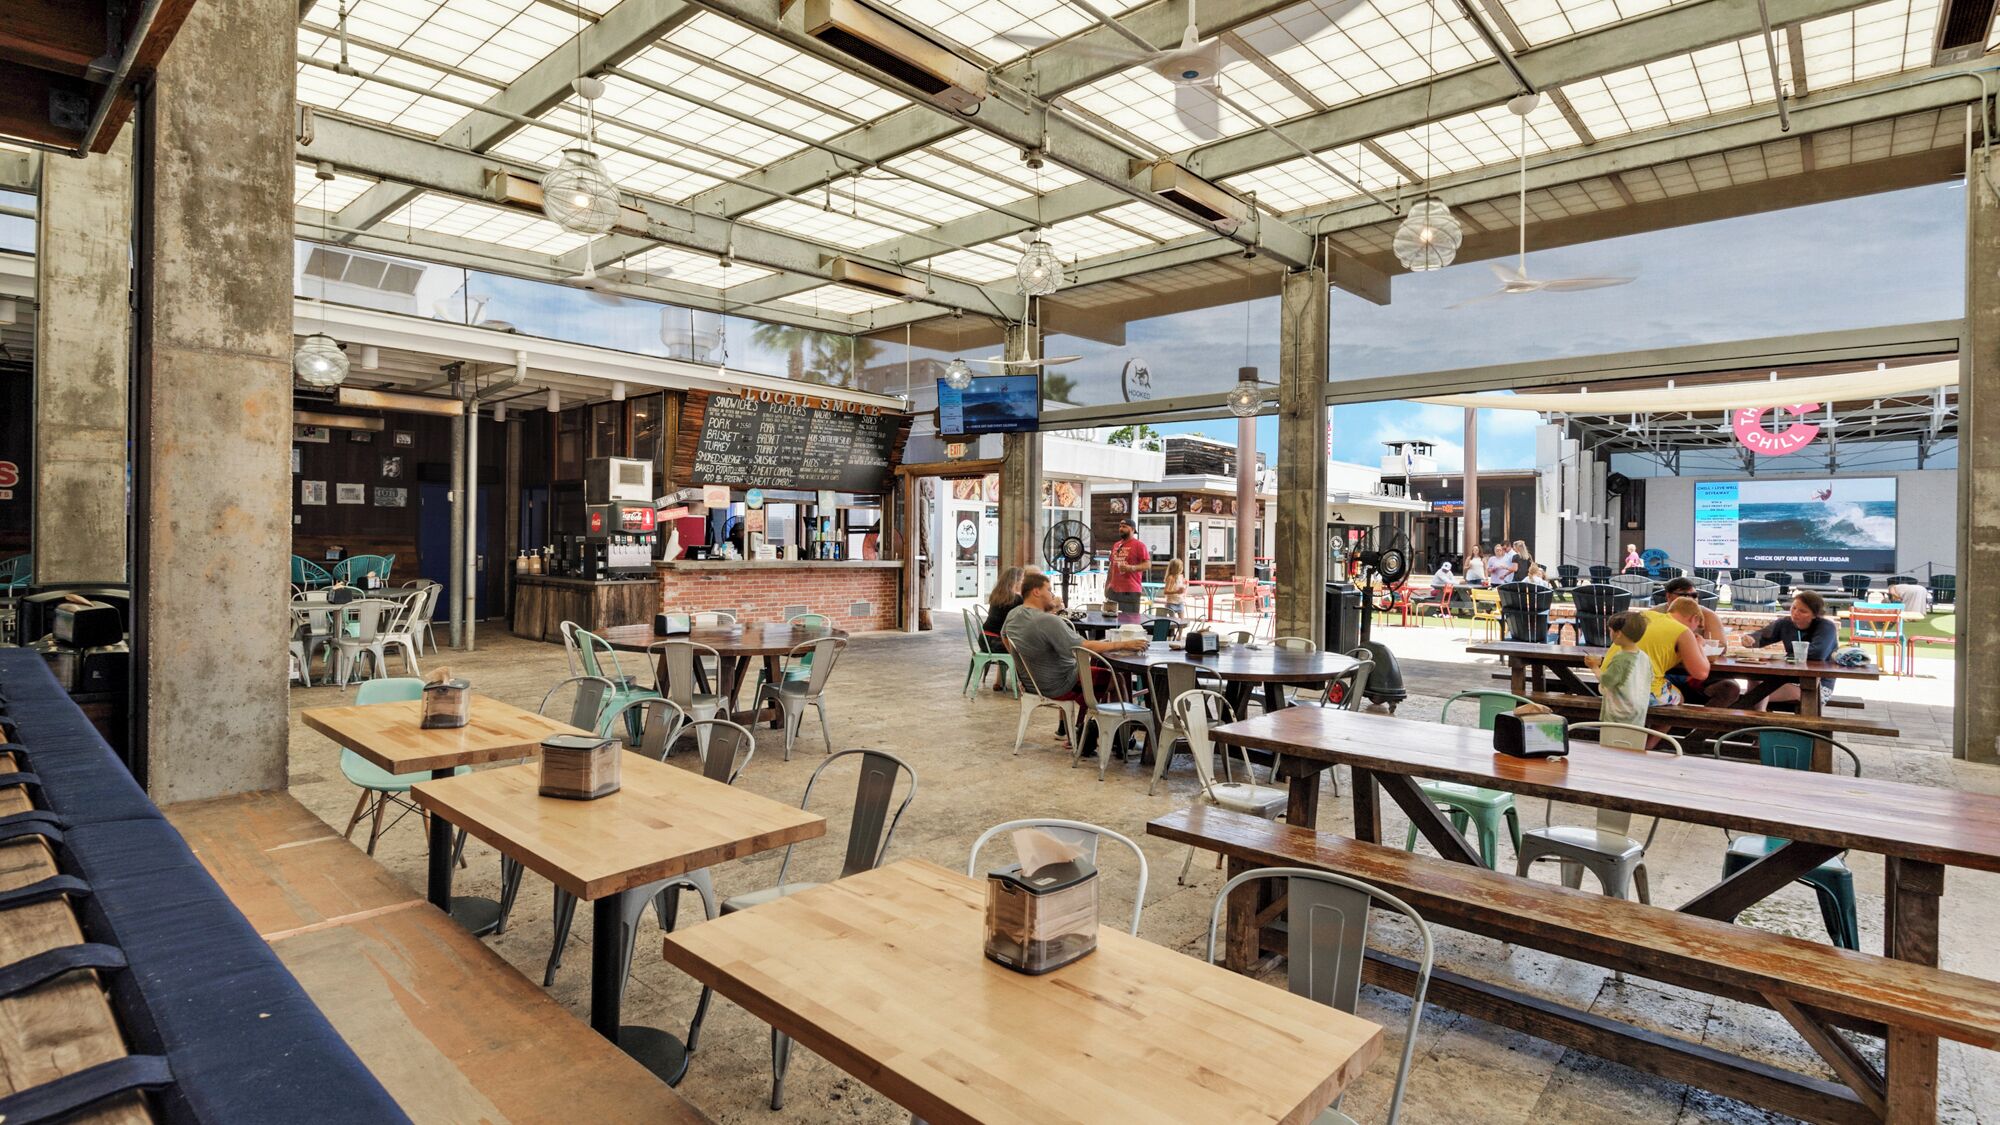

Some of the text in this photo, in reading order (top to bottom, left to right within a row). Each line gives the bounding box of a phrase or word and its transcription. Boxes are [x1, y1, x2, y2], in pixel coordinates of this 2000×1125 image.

[1128, 389, 1151, 399] HOOKED
[714, 396, 759, 411] SANDWICHES
[745, 386, 881, 416] LOCAL SMOKE
[769, 402, 806, 416] PLATTERS
[708, 417, 731, 430] PORK
[760, 422, 775, 433] PORK
[706, 429, 740, 441] BRISKET
[757, 433, 780, 445] BRISKET
[1747, 432, 1805, 449] CHILL
[703, 440, 731, 452] TURKEY
[756, 445, 779, 454] TURKEY
[950, 444, 960, 455] EXIT
[696, 450, 742, 464] SMOKED SAUSAGE
[753, 454, 779, 465] SAUSAGE
[803, 457, 820, 467] KIDS
[695, 462, 735, 475] BAKED POTATO
[703, 473, 715, 482] ADD
